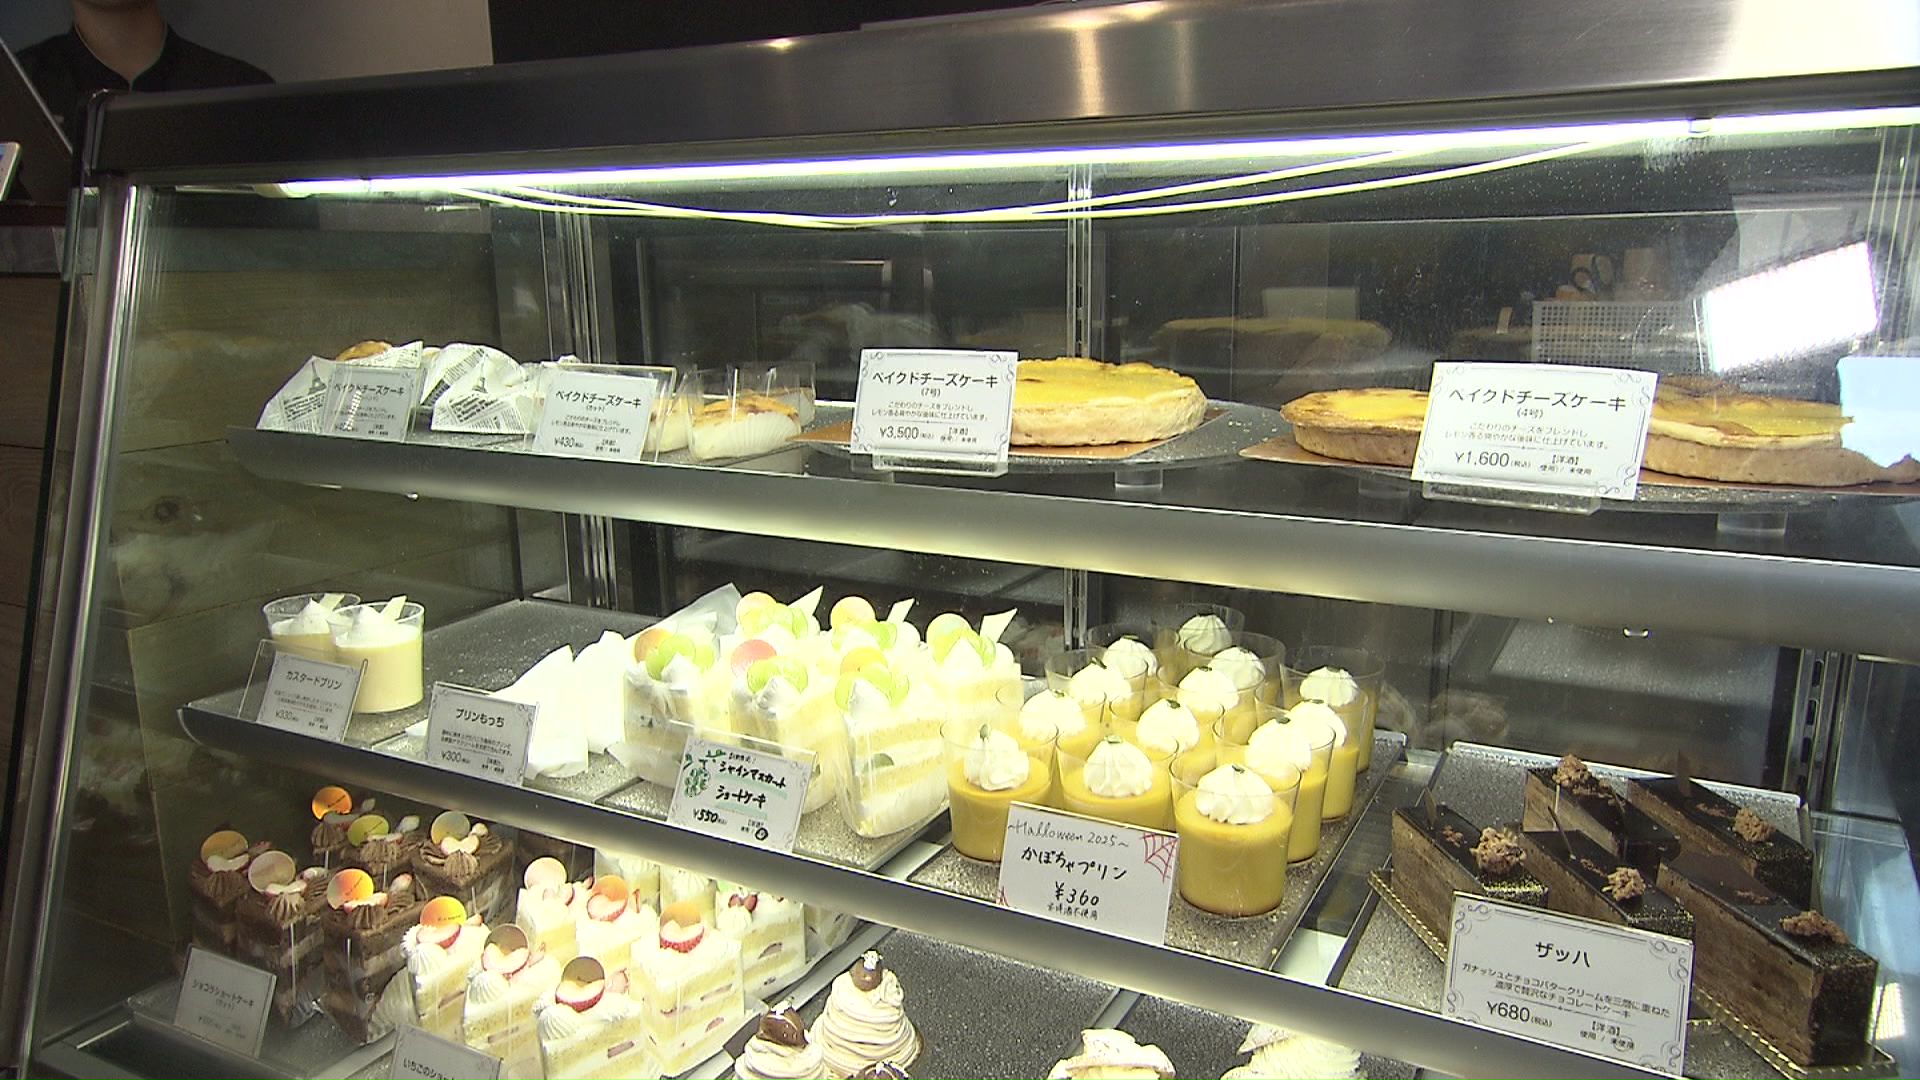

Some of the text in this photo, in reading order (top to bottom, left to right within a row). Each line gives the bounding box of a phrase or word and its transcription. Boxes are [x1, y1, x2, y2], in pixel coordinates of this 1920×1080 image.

[872, 371, 999, 389] ベイクドチーズケーキ
[555, 390, 642, 408] ベイクドチーズケーキ
[1449, 389, 1626, 412] ベイクドチーズケーキ
[880, 426, 919, 440] ¥3,500
[1455, 451, 1509, 468] ¥1,600
[286, 671, 342, 690] カスタードプリン
[456, 708, 505, 728] プリンもっち
[715, 784, 766, 809] ショートケーキ
[1020, 847, 1128, 880] かぼちゃプリン
[1535, 941, 1591, 968] ザッハ
[1486, 1001, 1530, 1023] ¥680
